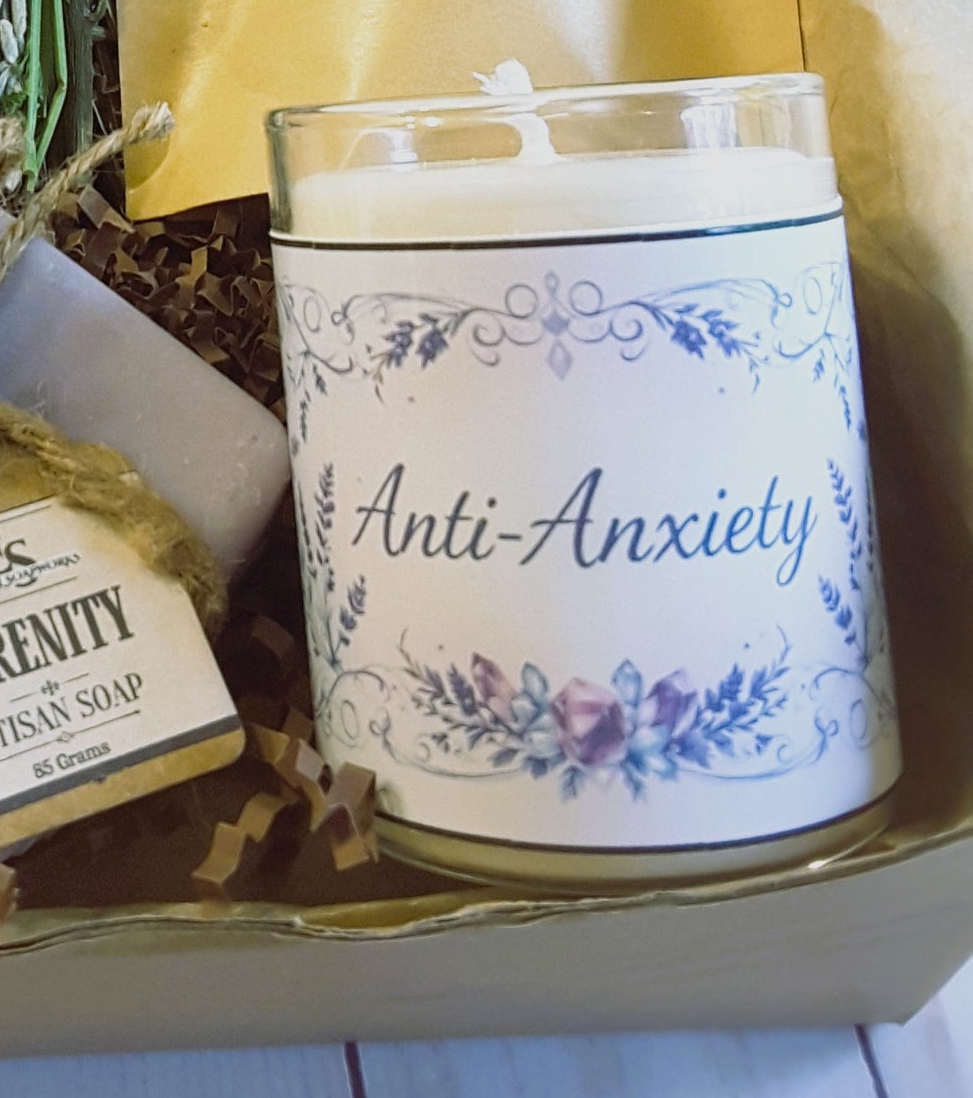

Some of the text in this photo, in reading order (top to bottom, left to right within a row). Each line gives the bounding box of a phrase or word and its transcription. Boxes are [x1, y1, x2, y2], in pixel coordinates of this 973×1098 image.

[351, 462, 819, 587] Anti-Anxiety
[75, 671, 144, 720] SOAP
[32, 740, 112, 780] 85 Grams
